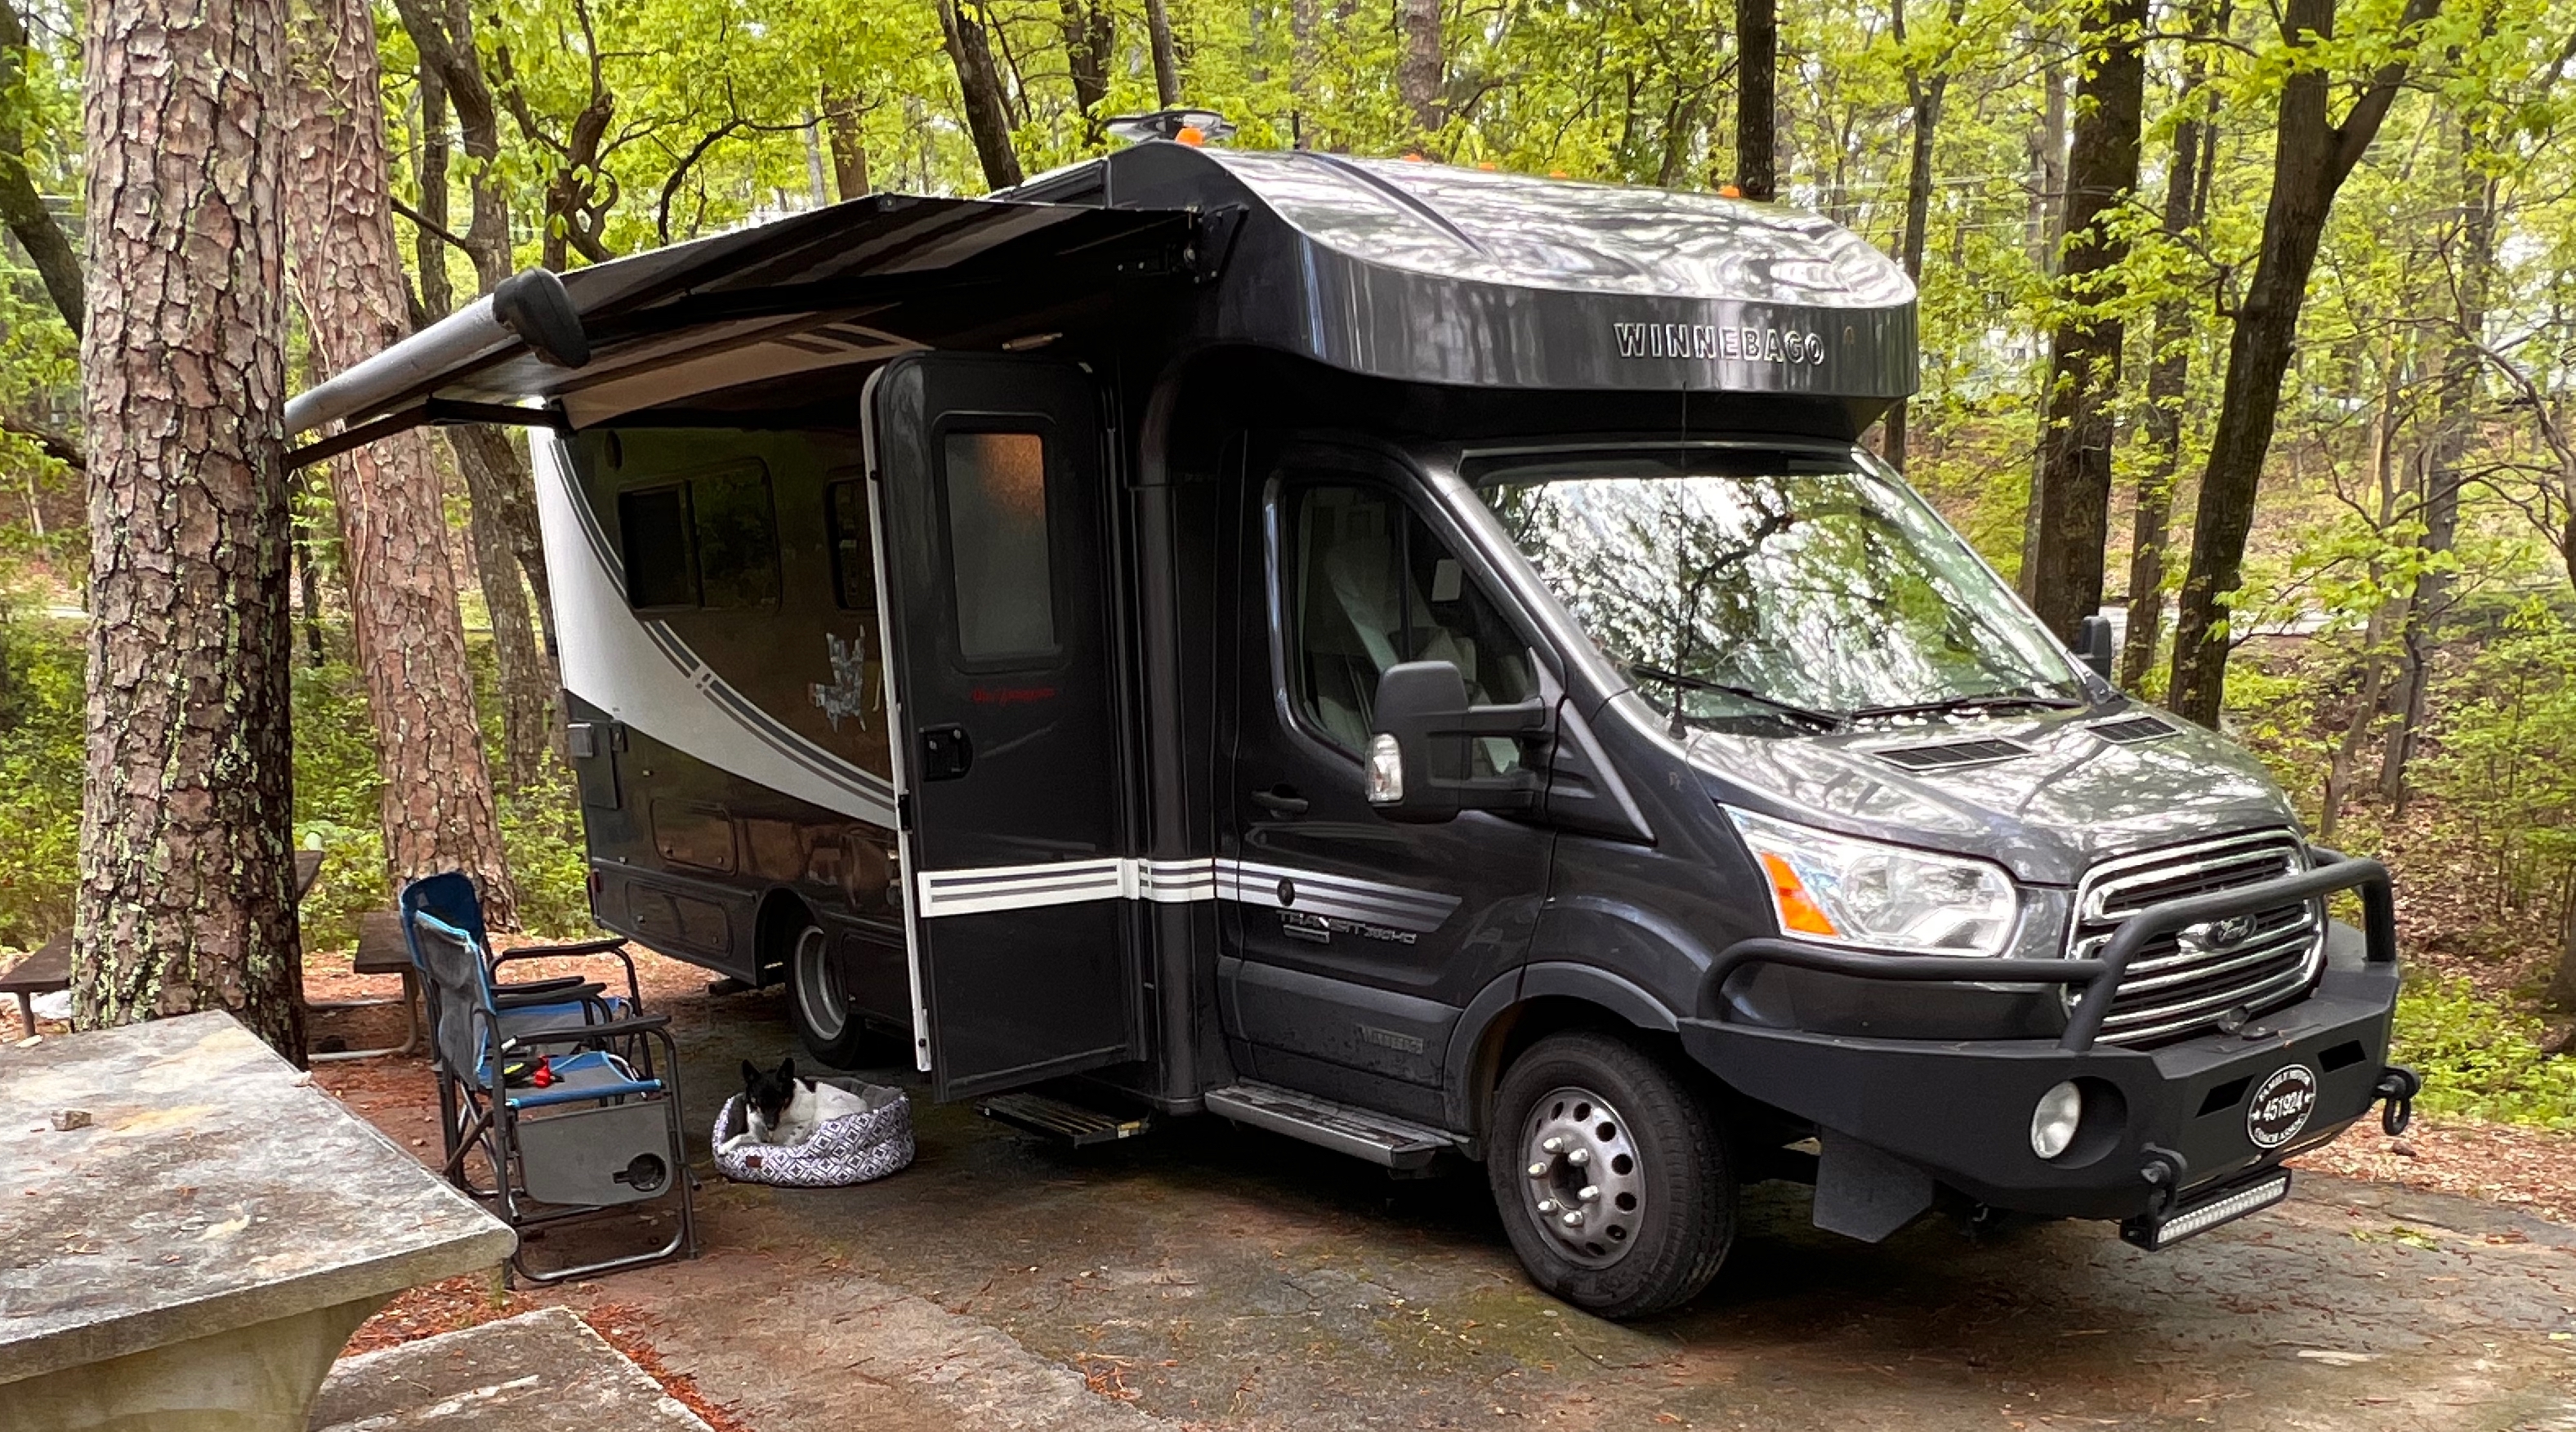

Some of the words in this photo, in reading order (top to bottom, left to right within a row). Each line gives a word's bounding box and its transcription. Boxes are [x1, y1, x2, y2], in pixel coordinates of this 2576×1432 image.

[1614, 323, 1825, 365] WINNEBAGO
[1277, 910, 1366, 935] TRANSIT
[2217, 916, 2250, 943] Ford
[2262, 1089, 2304, 1122] 451924
